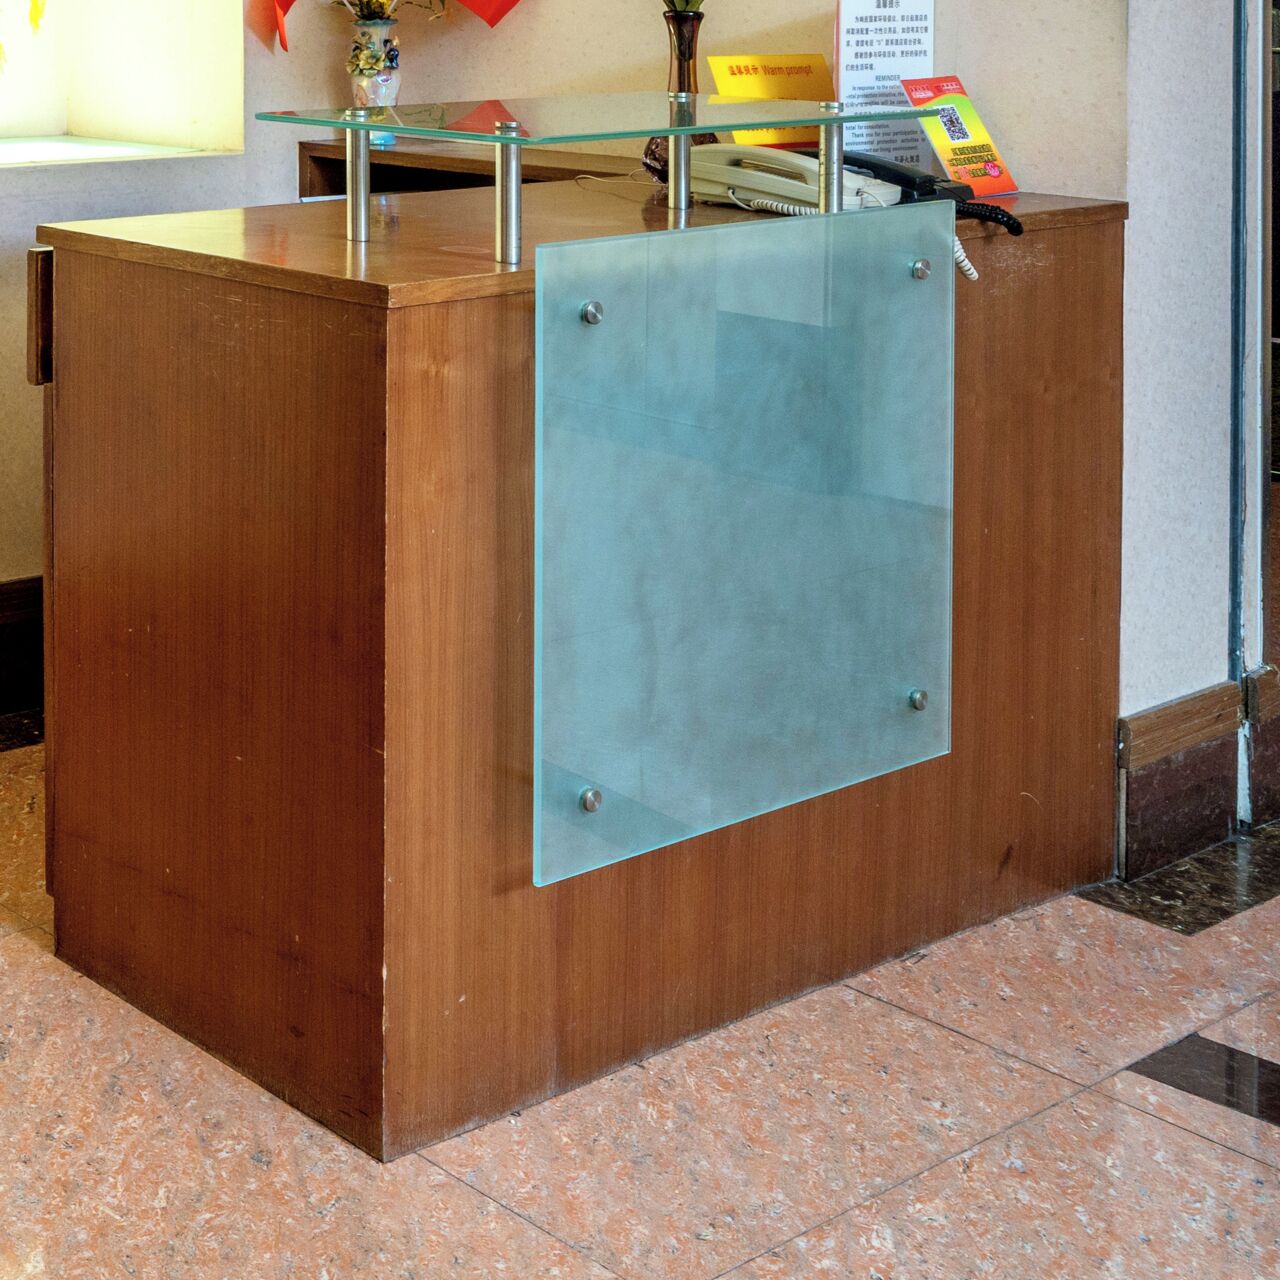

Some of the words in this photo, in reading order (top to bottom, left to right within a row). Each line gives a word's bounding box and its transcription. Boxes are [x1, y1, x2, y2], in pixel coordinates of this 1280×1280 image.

[761, 65, 785, 76] Warm
[785, 64, 813, 77] prompt
[875, 74, 901, 82] REMINDER
